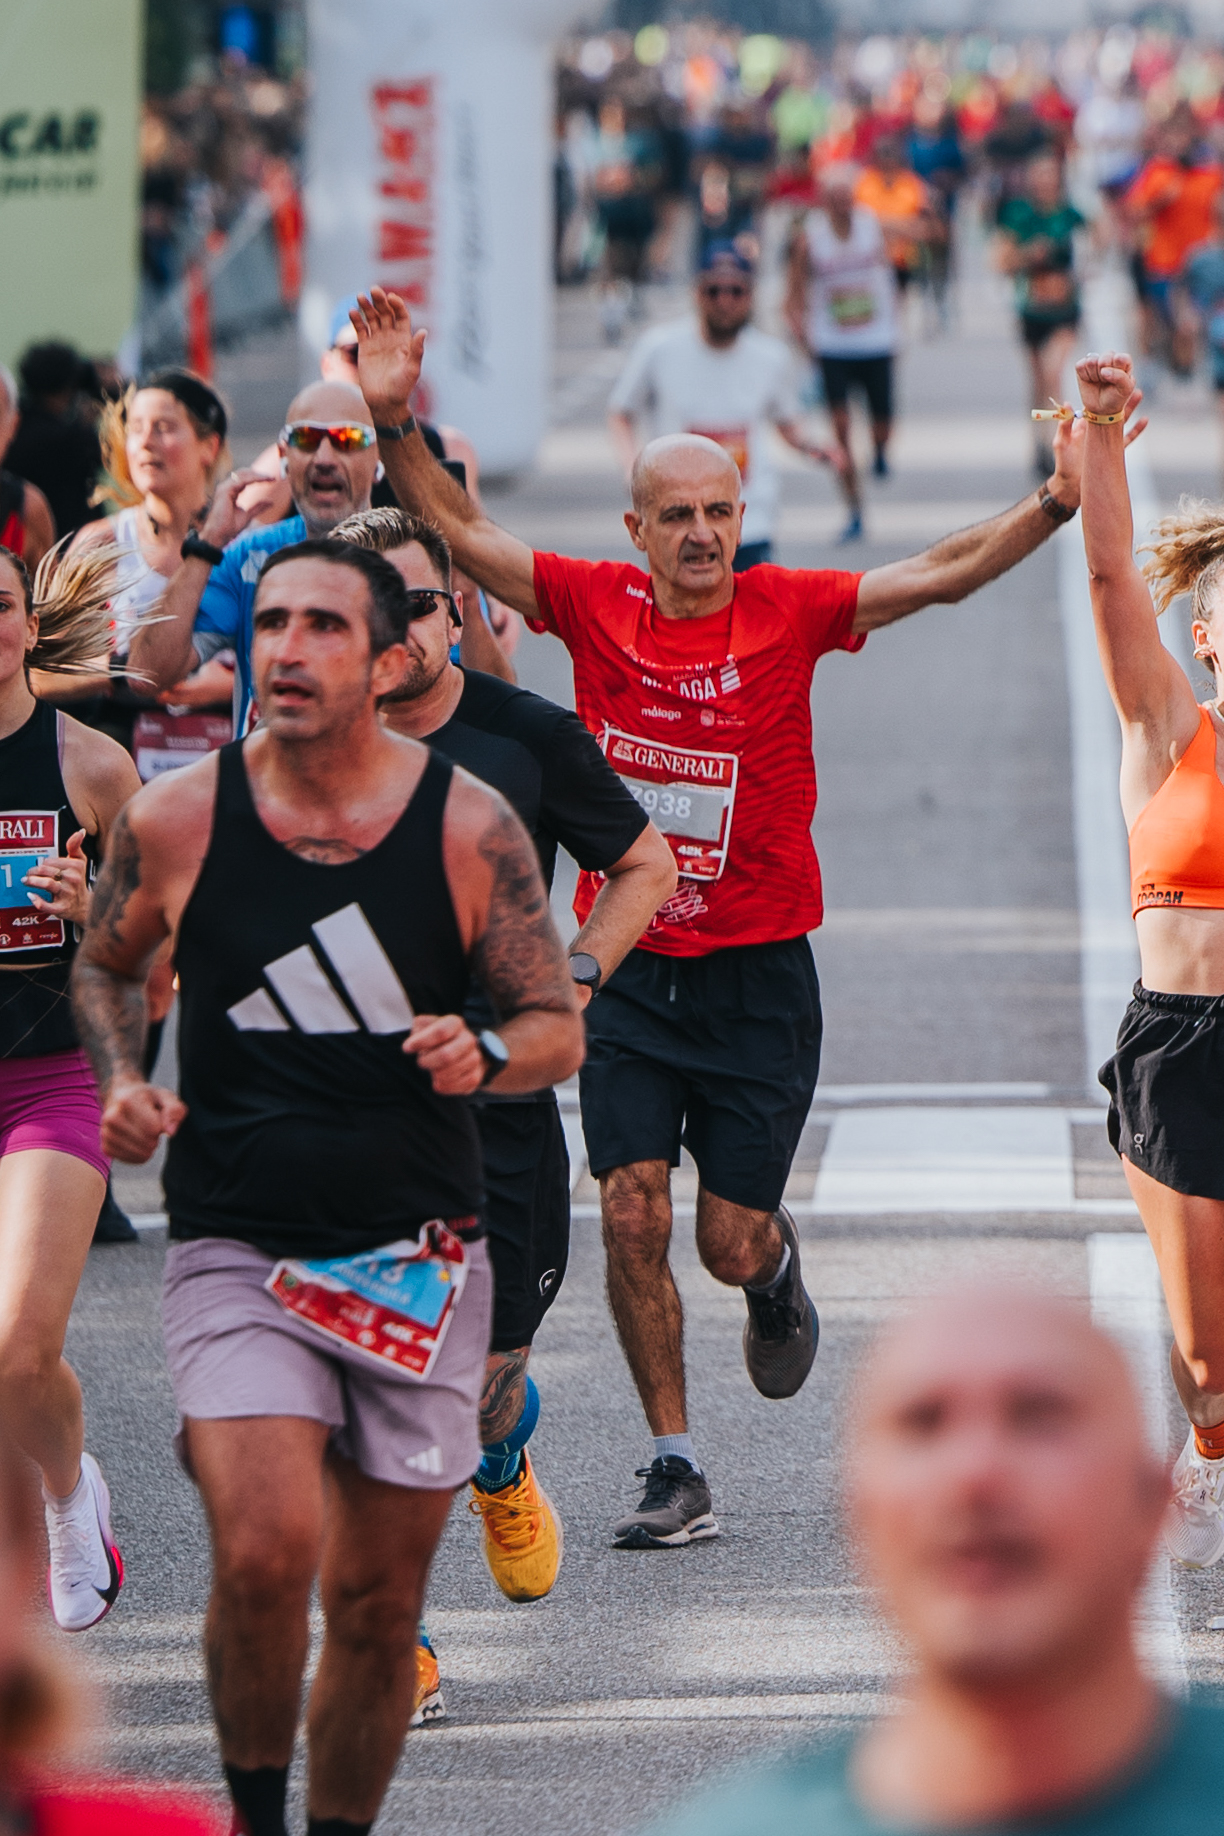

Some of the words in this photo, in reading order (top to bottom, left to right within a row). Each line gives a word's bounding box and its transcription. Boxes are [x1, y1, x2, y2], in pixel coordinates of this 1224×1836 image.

[634, 747, 726, 781] GENERALI
[677, 844, 704, 858] 42K
[12, 915, 40, 927] 42K
